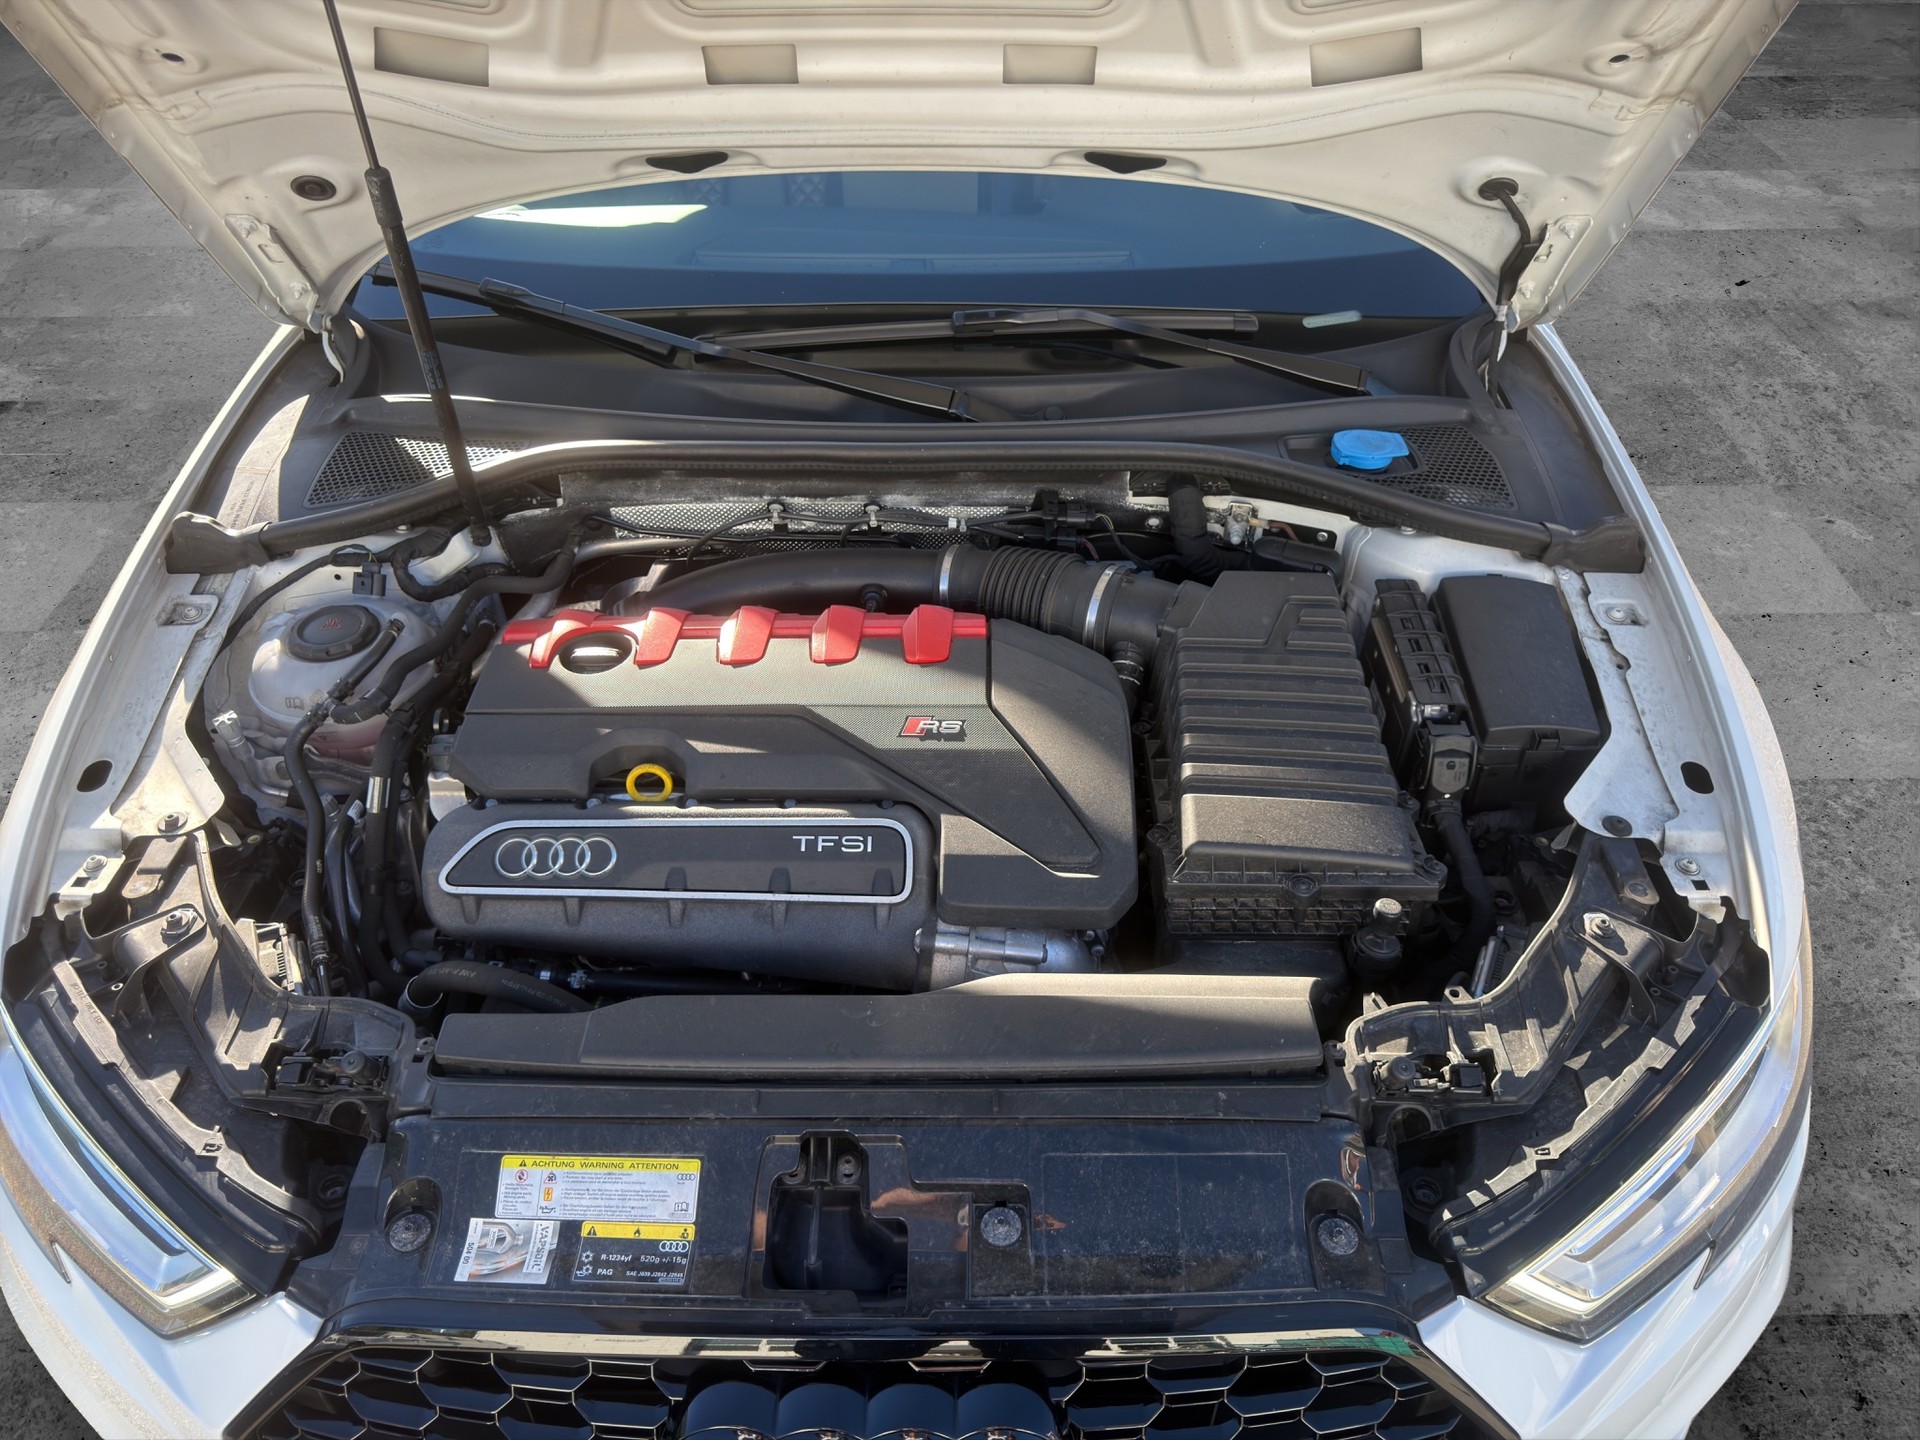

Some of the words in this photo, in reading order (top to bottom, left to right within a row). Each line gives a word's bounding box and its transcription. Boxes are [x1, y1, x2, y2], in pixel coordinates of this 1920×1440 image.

[916, 720, 963, 734] RS
[792, 835, 873, 853] TFSI
[531, 1160, 575, 1169] ACHTUNG
[580, 1161, 625, 1170] WARNING
[628, 1162, 680, 1171] ATTENTION
[466, 1242, 475, 1254] 504
[640, 1255, 660, 1264] 520g
[597, 1268, 613, 1276] PAG
